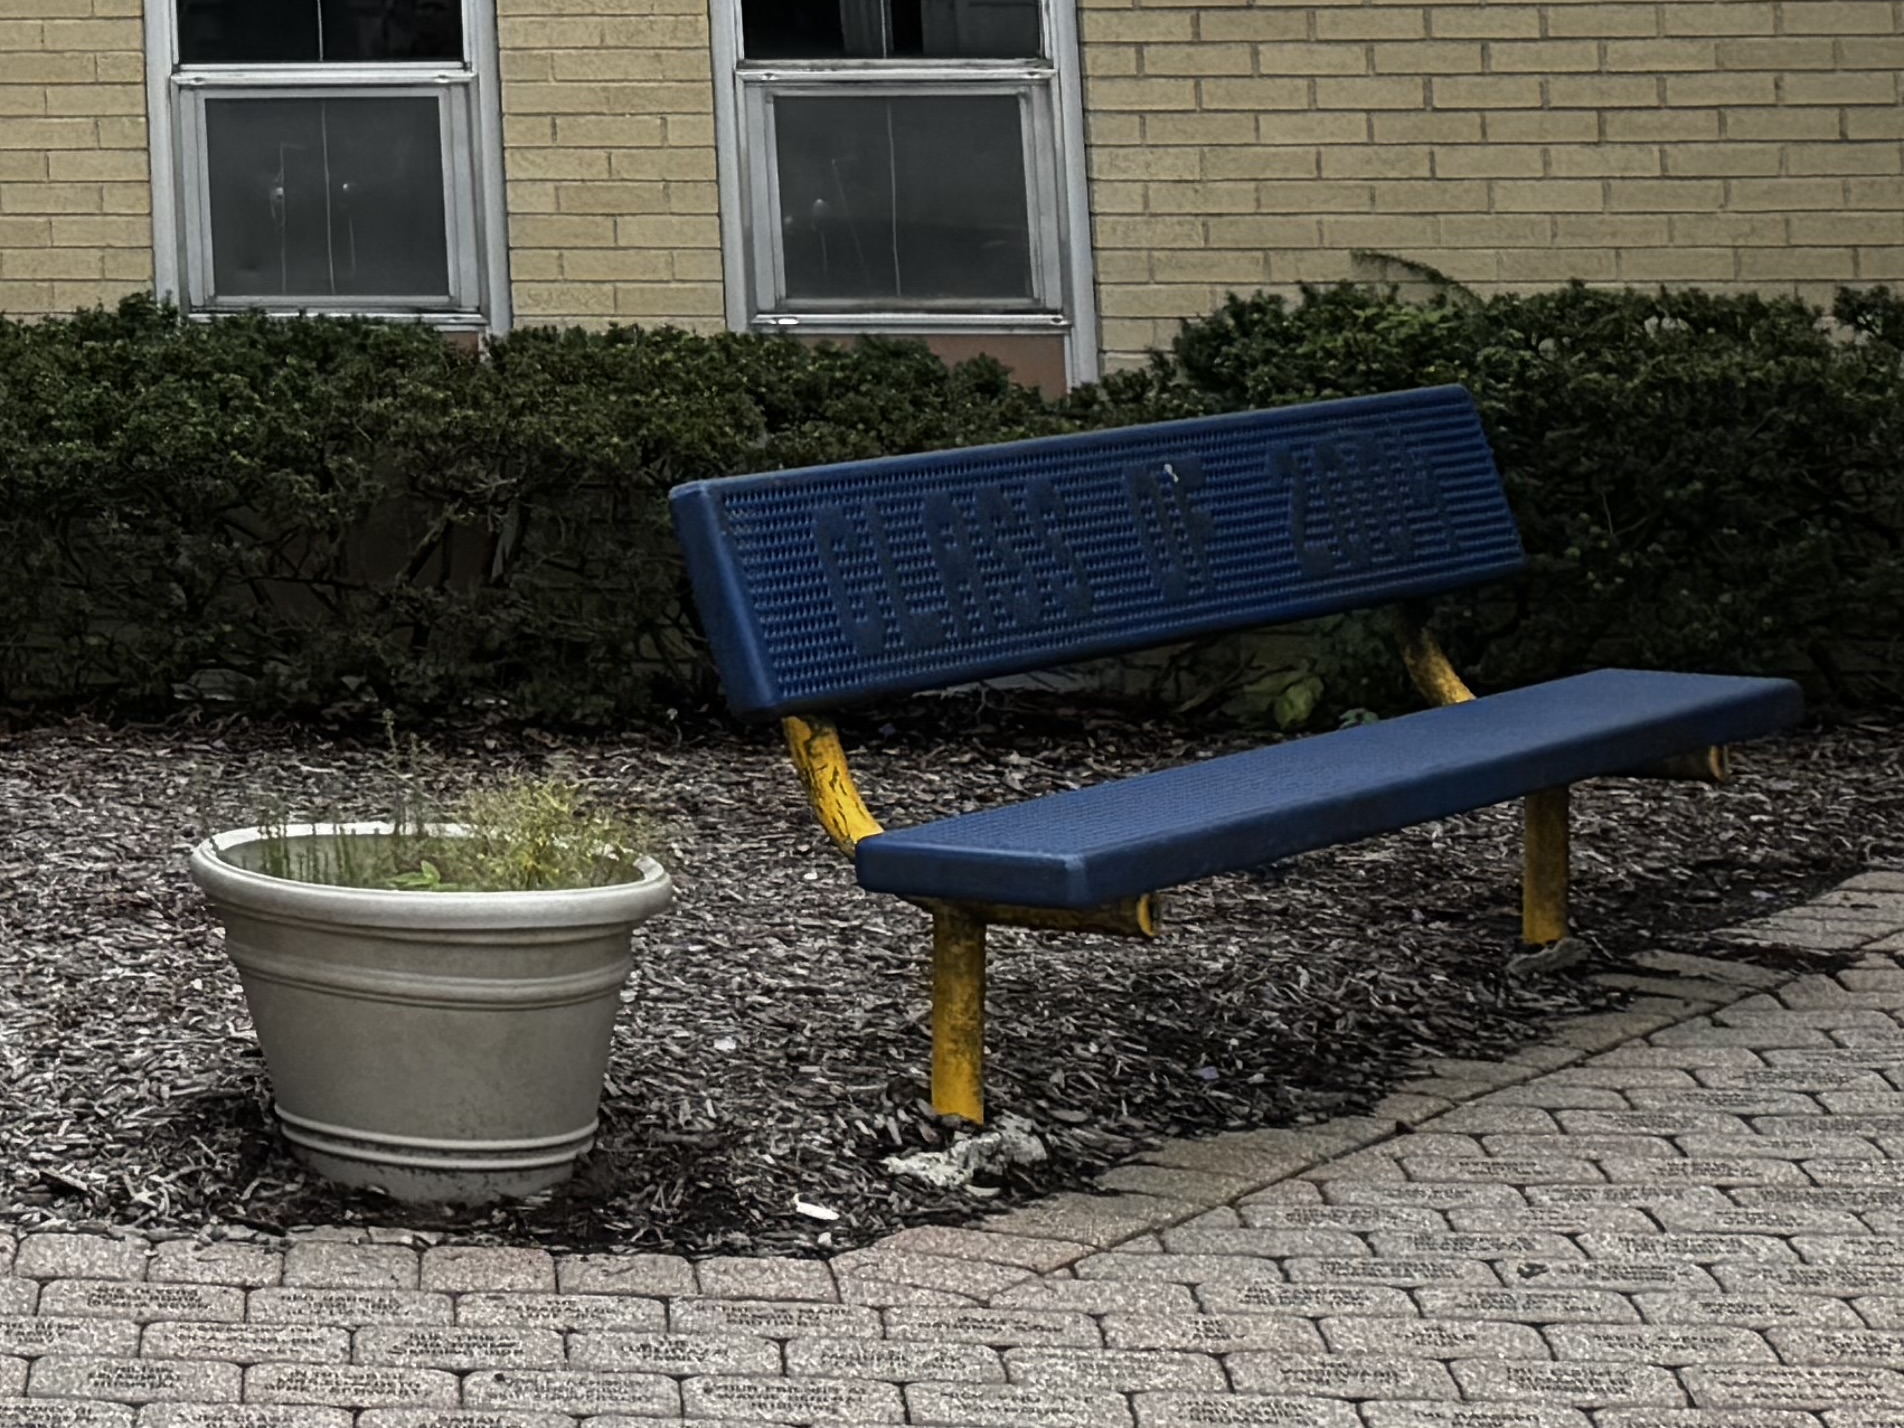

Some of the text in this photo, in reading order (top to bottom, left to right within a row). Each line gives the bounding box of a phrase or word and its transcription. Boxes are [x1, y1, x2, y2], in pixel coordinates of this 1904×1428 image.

[813, 427, 1460, 655] CLASS OF 2004
